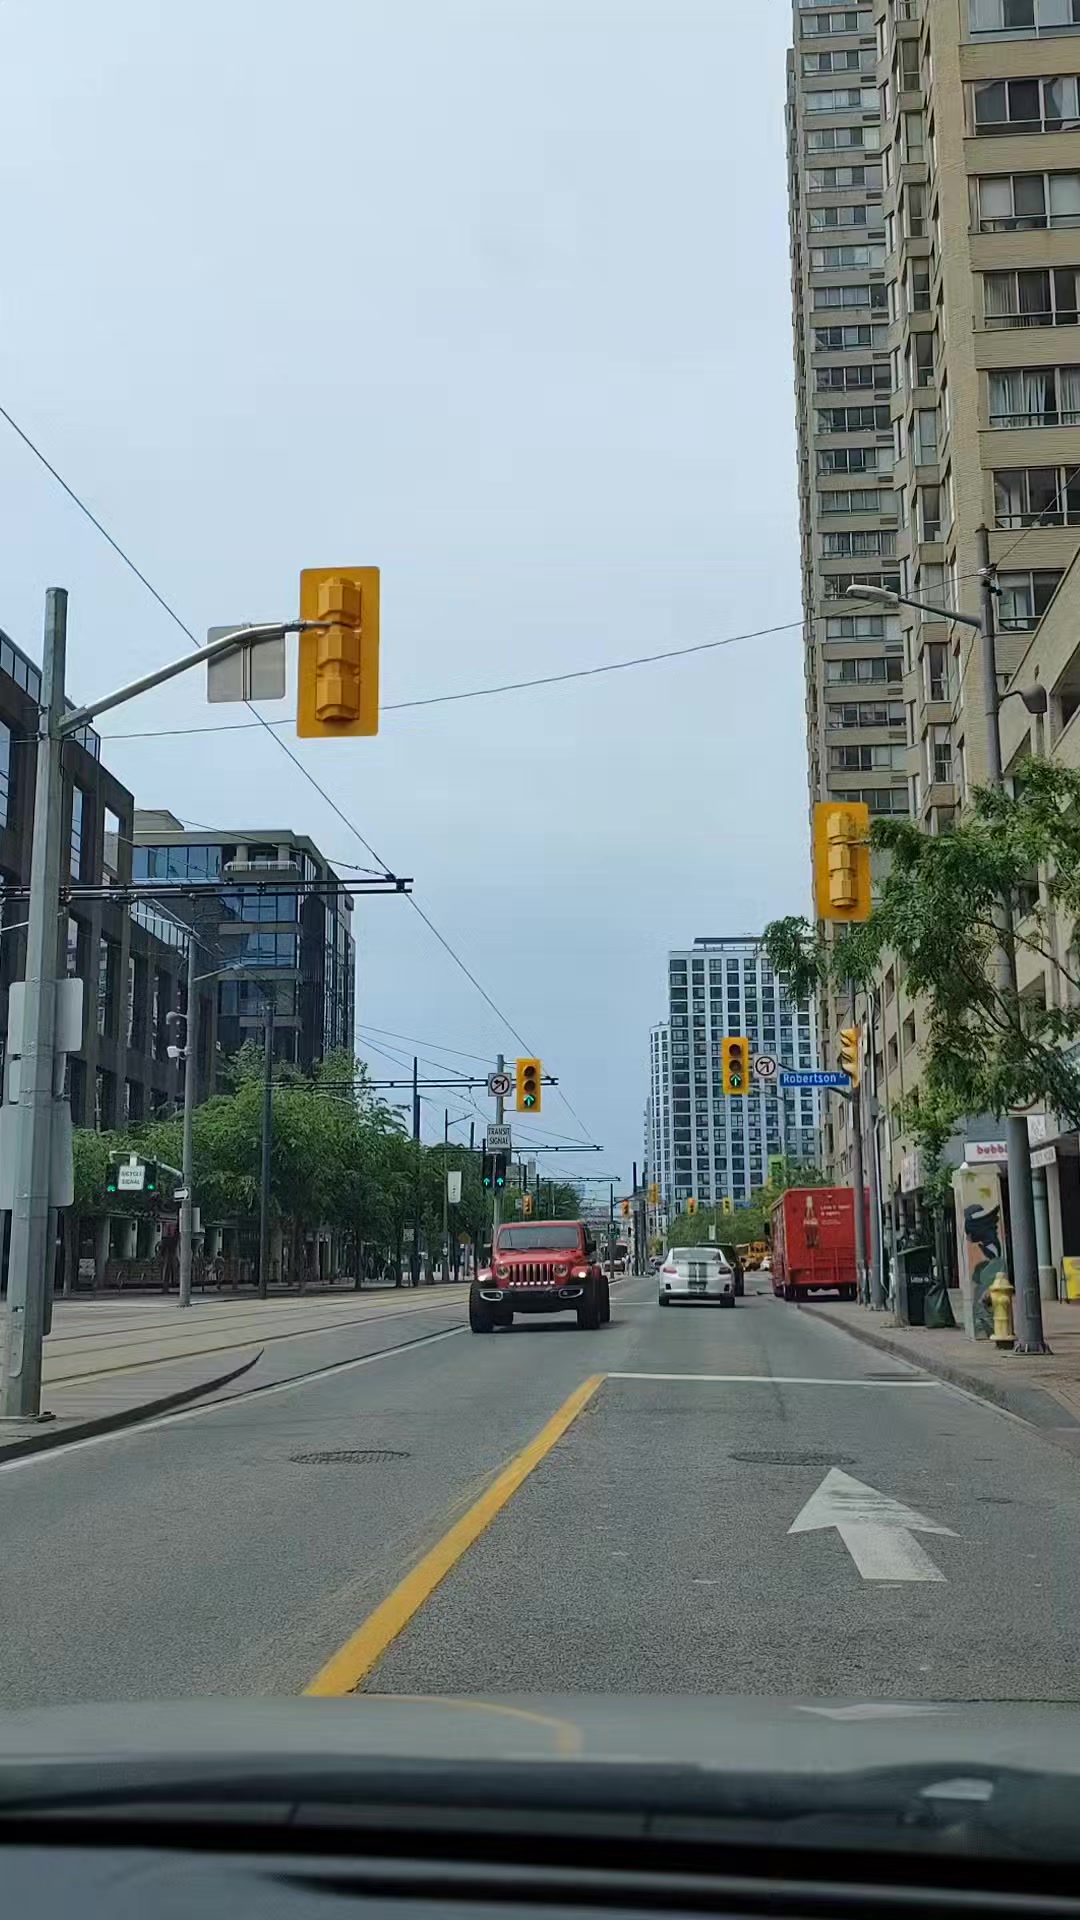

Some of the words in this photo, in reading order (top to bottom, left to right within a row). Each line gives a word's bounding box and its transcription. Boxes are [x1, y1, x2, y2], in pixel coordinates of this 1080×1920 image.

[783, 1073, 836, 1084] Robertson
[488, 1128, 510, 1136] TRANSIT
[489, 1137, 508, 1145] SIGNAL
